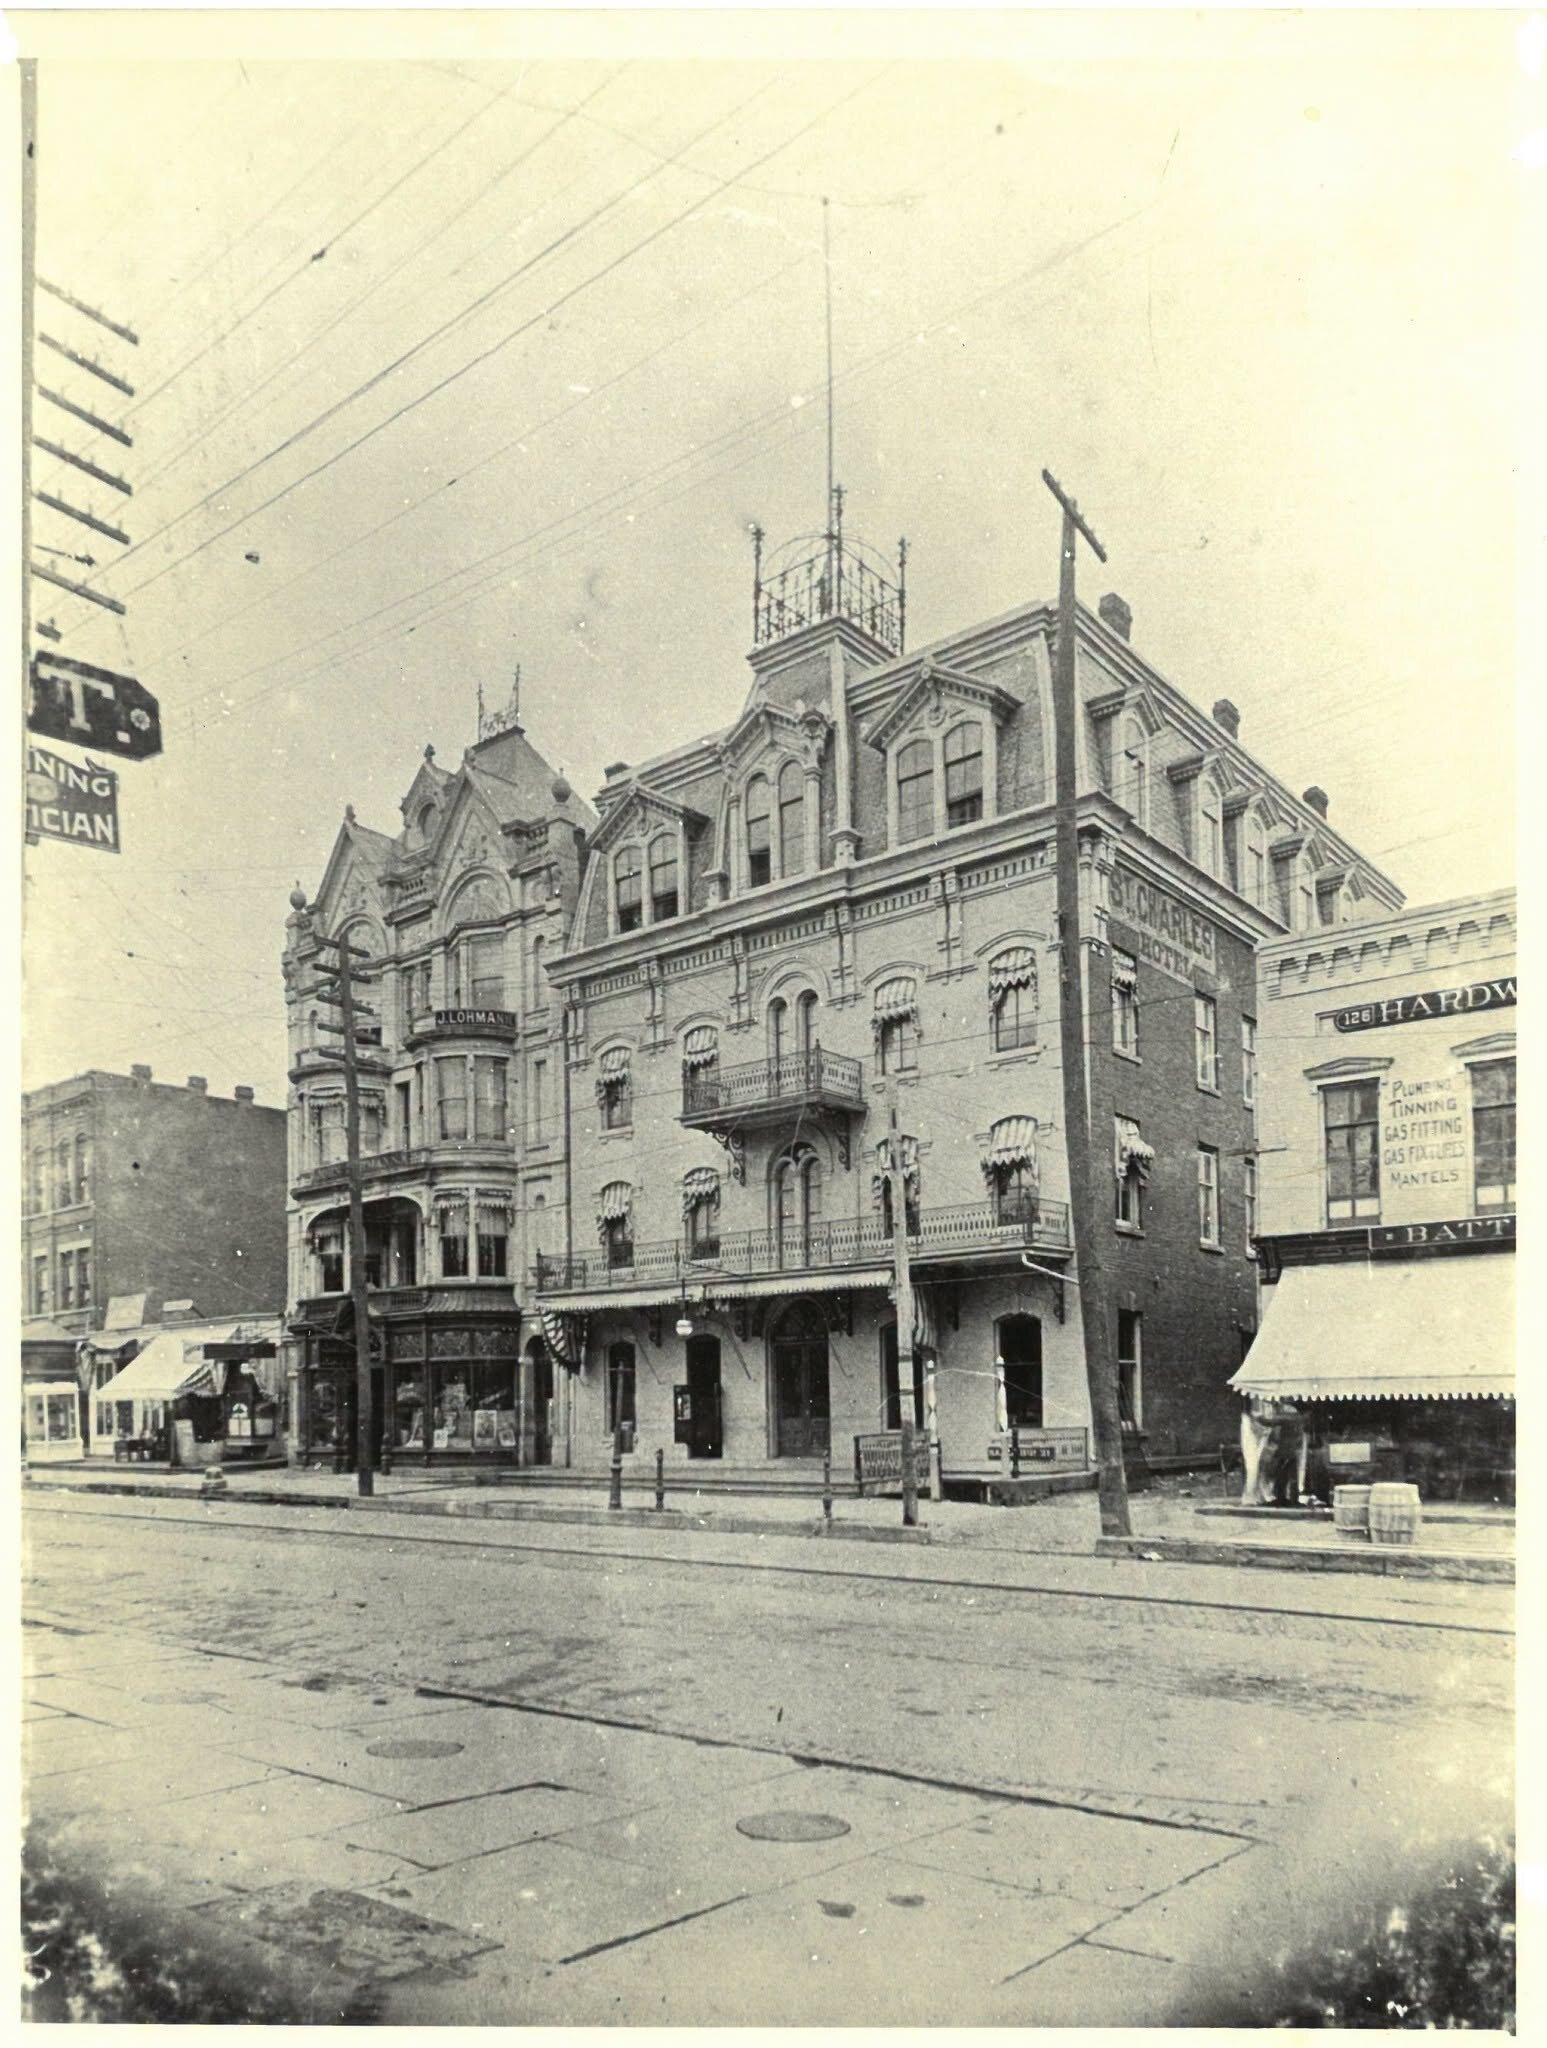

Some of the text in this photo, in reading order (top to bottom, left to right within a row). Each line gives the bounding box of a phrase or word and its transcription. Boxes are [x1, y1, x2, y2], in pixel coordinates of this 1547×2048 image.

[26, 804, 114, 844] ICIAN
[1344, 1010, 1370, 1025] 126
[1389, 1099, 1457, 1118] TINNING
[1385, 1117, 1462, 1142] GAS FITTING
[1384, 1148, 1405, 1165] GAS
